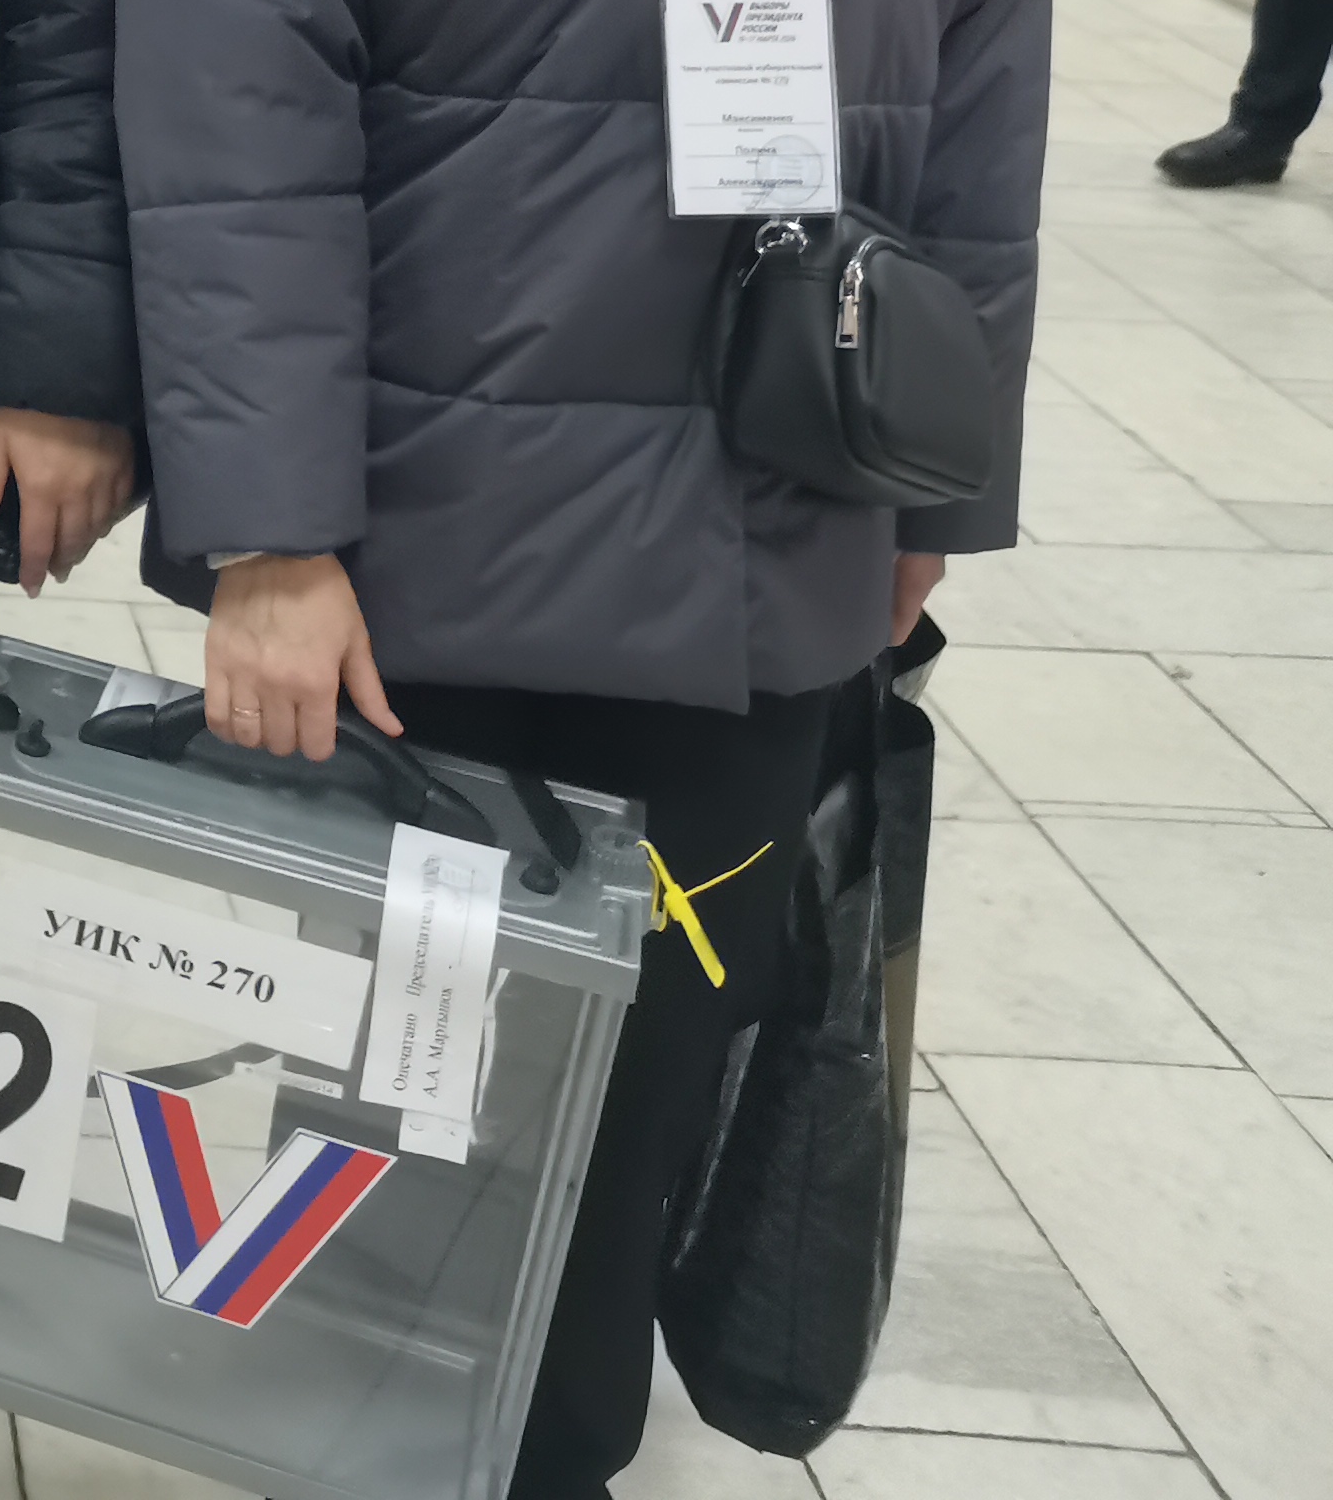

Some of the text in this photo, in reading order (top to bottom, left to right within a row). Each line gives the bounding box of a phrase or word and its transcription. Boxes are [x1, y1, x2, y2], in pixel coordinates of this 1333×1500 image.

[745, 12, 803, 22] ПРЕЗИДЕНТА
[749, 2, 790, 10] ВЫБОРЫ
[741, 24, 778, 33] РОССИИ
[43, 907, 275, 1003] УИК № 270
[392, 1013, 418, 1092] Опечатано
[406, 899, 436, 997] Председатель
[428, 986, 453, 1061] Мартынюк
